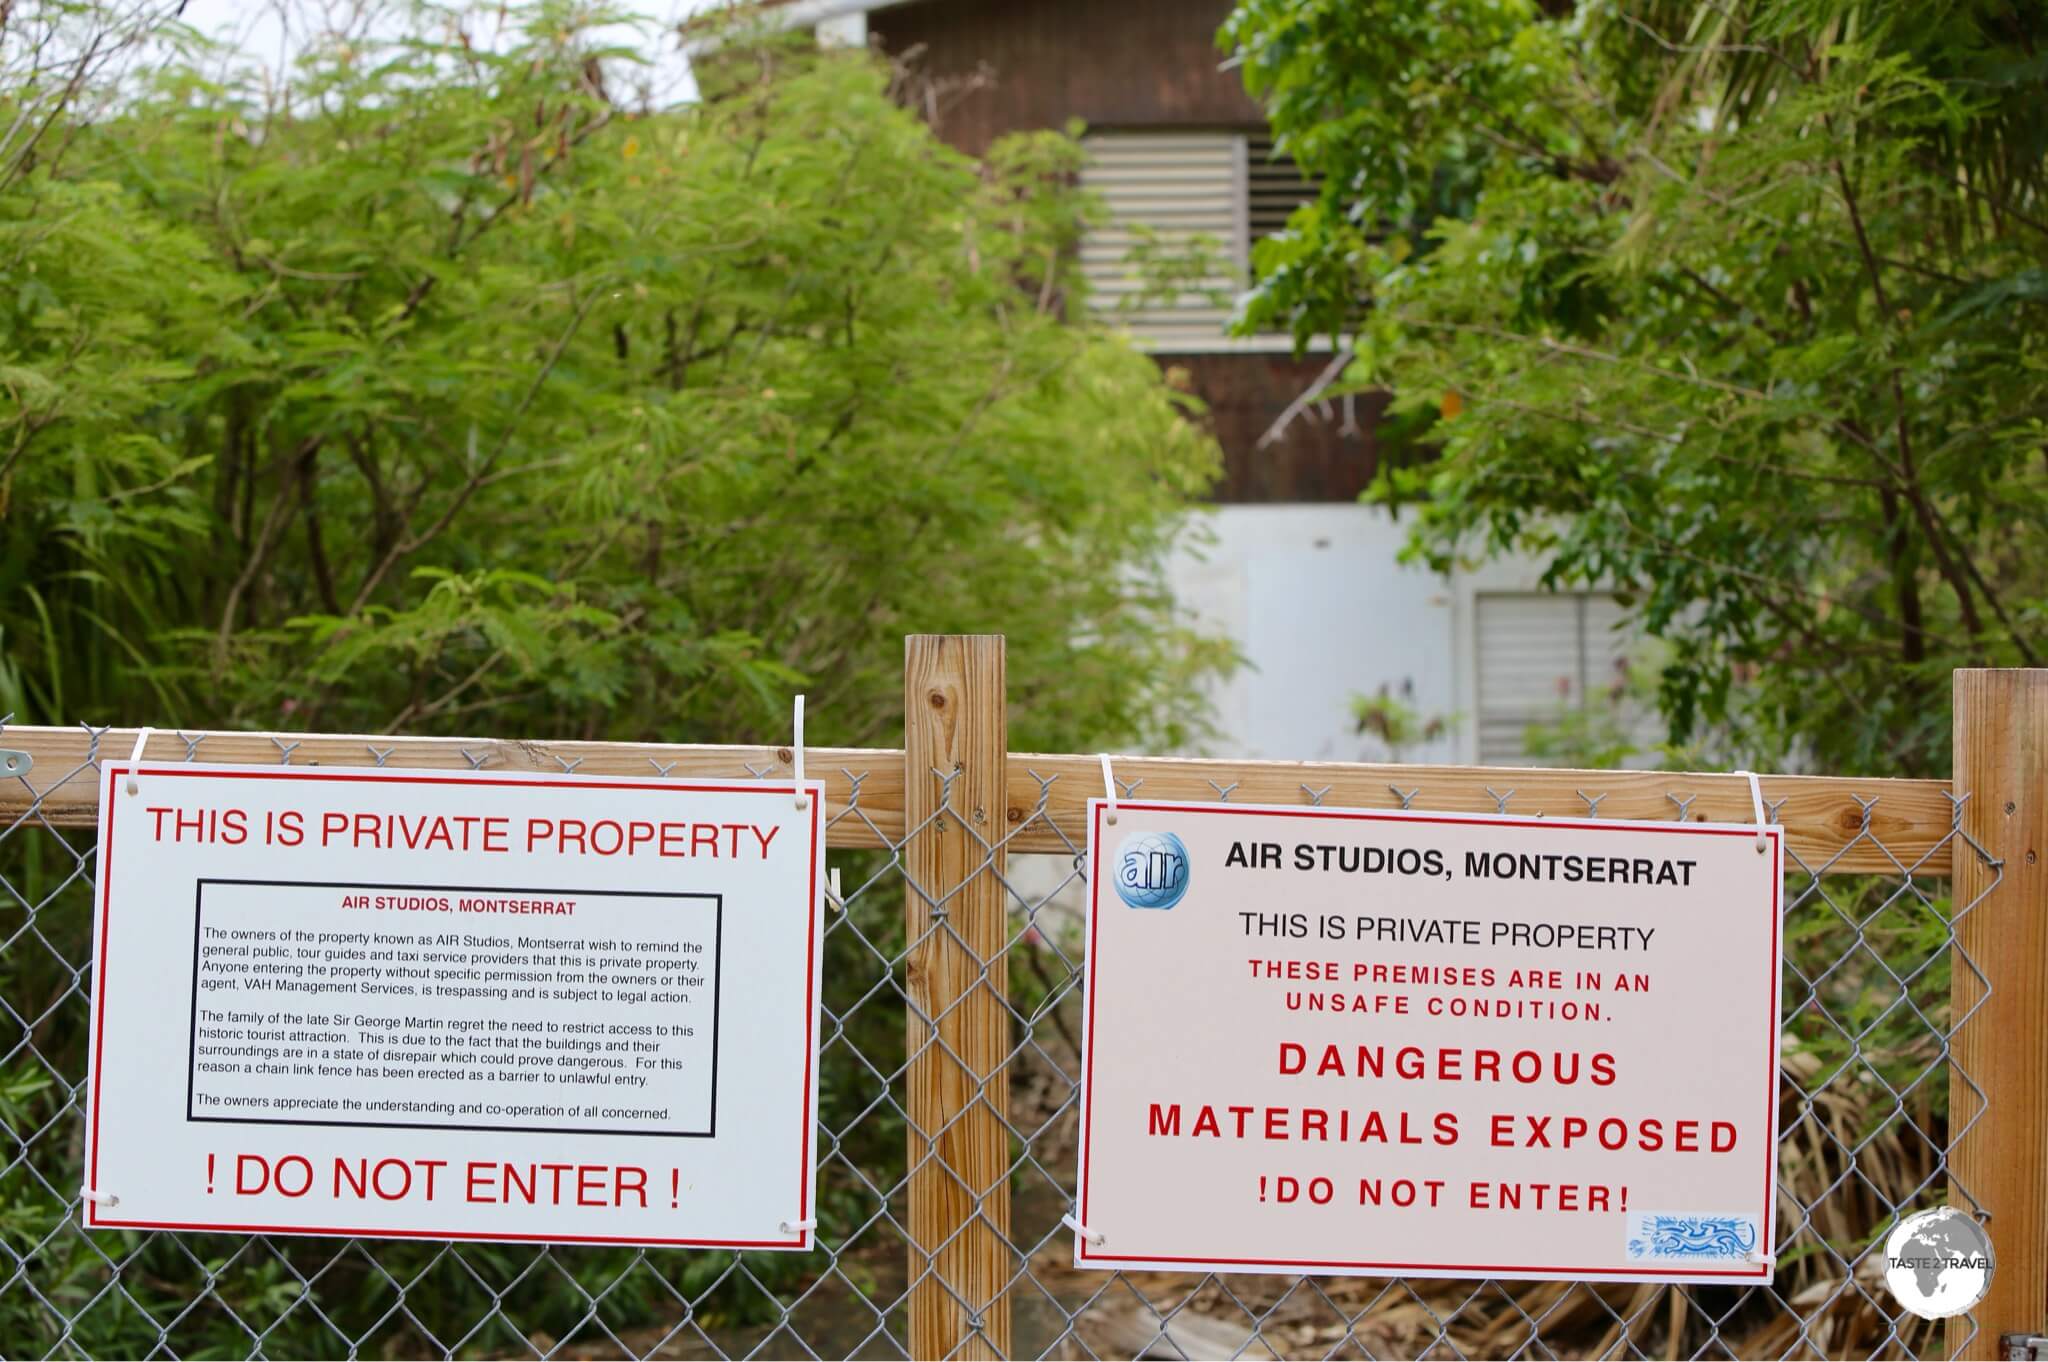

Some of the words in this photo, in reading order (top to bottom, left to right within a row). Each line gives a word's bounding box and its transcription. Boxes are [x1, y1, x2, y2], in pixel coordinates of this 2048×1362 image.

[145, 806, 247, 845] THIS
[265, 810, 304, 847] IS
[321, 811, 509, 852] PRIVATE
[526, 817, 780, 860] PROPERTY
[1224, 840, 1282, 869] AIR
[1293, 843, 1452, 882] STUDIOS,
[1464, 850, 1697, 886] MONTSERRAT
[341, 895, 369, 909] AIR
[374, 895, 453, 914] STUDIOS,
[458, 898, 576, 915] MONTSERRAT
[202, 926, 227, 939] The
[230, 929, 276, 941] owners
[279, 929, 292, 941] of
[295, 929, 314, 942] the
[318, 932, 370, 946] property
[373, 931, 413, 944] known
[417, 935, 432, 945] as
[435, 933, 459, 947] AIR
[463, 934, 513, 949] Studios,
[517, 935, 584, 950] Montserrat
[588, 938, 616, 951] wish
[620, 939, 632, 952] to
[636, 940, 679, 952] remind
[683, 940, 702, 953] the
[1238, 911, 1307, 938] THIS
[1319, 914, 1345, 940] IS
[1356, 915, 1480, 945] PRIVATE
[1491, 921, 1655, 951] PROPERTY
[201, 944, 249, 958] general
[252, 945, 292, 959] public,
[296, 946, 321, 958] tour
[324, 947, 366, 962] guides
[369, 948, 393, 960] and
[397, 949, 419, 962] taxi
[422, 951, 467, 963] service
[470, 952, 528, 966] providers
[532, 953, 556, 966] that
[559, 954, 582, 966] this
[585, 954, 595, 967] is
[599, 955, 641, 970] private
[645, 958, 699, 972] property.
[201, 959, 249, 975] Anyone
[252, 962, 303, 977] entering
[306, 963, 326, 975] the
[329, 965, 381, 979] property
[385, 966, 430, 979] without
[433, 967, 480, 981] specific
[484, 969, 552, 984] permission
[556, 970, 584, 983] from
[587, 971, 608, 984] the
[611, 974, 656, 985] owners
[660, 975, 673, 986] or
[677, 974, 704, 987] their
[1247, 959, 1339, 981] THESE
[1353, 962, 1495, 987] PREMISES
[1507, 968, 1562, 989] ARE
[1575, 971, 1601, 991] IN
[1613, 972, 1649, 992] AN
[200, 978, 239, 991] agent,
[243, 977, 271, 990] VAH
[275, 978, 356, 995] Management
[360, 981, 417, 996] Services,
[421, 983, 432, 996] is
[436, 984, 507, 1000] trespassing
[511, 986, 535, 998] and
[538, 986, 549, 999] is
[552, 987, 597, 1003] subject
[601, 989, 613, 1001] to
[617, 989, 646, 1004] legal
[650, 990, 691, 1003] action.
[1285, 991, 1408, 1014] UNSAFE
[1427, 996, 1611, 1022] CONDITION.
[199, 1009, 223, 1022] The
[227, 1010, 264, 1026] family
[267, 1011, 280, 1024] of
[283, 1012, 303, 1024] the
[306, 1012, 329, 1025] late
[332, 1013, 351, 1026] Sir
[354, 1014, 400, 1031] George
[404, 1015, 443, 1029] Martin
[447, 1018, 484, 1033] regret
[488, 1018, 507, 1031] the
[511, 1019, 542, 1032] need
[546, 1020, 558, 1032] to
[562, 1021, 604, 1034] restrict
[608, 1024, 652, 1035] access
[655, 1024, 668, 1036] to
[671, 1023, 693, 1036] this
[198, 1026, 243, 1040] historic
[247, 1028, 285, 1041] tourist
[288, 1029, 349, 1043] attraction.
[357, 1031, 384, 1044] This
[388, 1032, 398, 1044] is
[401, 1032, 426, 1045] due
[429, 1034, 441, 1046] to
[445, 1034, 464, 1046] the
[468, 1034, 491, 1048] fact
[494, 1035, 519, 1048] that
[522, 1036, 542, 1049] the
[545, 1036, 601, 1053] buildings
[604, 1039, 628, 1051] and
[632, 1039, 660, 1052] their
[198, 1044, 279, 1060] surroundings
[282, 1048, 303, 1058] are
[306, 1046, 317, 1058] in
[321, 1049, 329, 1059] a
[332, 1048, 363, 1060] state
[367, 1047, 379, 1061] of
[382, 1048, 437, 1064] disrepair
[440, 1050, 476, 1063] which
[480, 1052, 514, 1064] could
[517, 1055, 553, 1068] prove
[556, 1054, 627, 1070] dangerous.
[635, 1056, 657, 1069] For
[660, 1057, 683, 1070] this
[1278, 1041, 1616, 1086] DANGEROUS
[197, 1062, 240, 1072] reason
[243, 1063, 252, 1073] a
[255, 1061, 289, 1074] chain
[292, 1062, 314, 1075] link
[317, 1063, 352, 1076] fence
[356, 1064, 378, 1077] has
[382, 1065, 413, 1078] been
[417, 1068, 464, 1080] erected
[468, 1070, 483, 1080] as
[487, 1071, 495, 1081] a
[498, 1069, 540, 1082] barrier
[543, 1071, 555, 1083] to
[559, 1071, 610, 1085] unlawful
[614, 1073, 648, 1088] entry.
[195, 1092, 220, 1105] The
[223, 1096, 269, 1107] owners
[272, 1096, 338, 1111] appreciate
[342, 1097, 362, 1110] the
[365, 1098, 454, 1116] understanding
[458, 1101, 482, 1114] and
[485, 1103, 564, 1118] co-operation
[567, 1104, 580, 1117] of
[583, 1104, 597, 1118] all
[601, 1107, 670, 1120] concerned.
[1148, 1103, 1459, 1146] MATERIALS
[1490, 1114, 1737, 1153] EXPOSED
[206, 1152, 215, 1194] !
[235, 1153, 313, 1198] DO
[333, 1156, 447, 1201] NOT
[465, 1160, 648, 1208] ENTER
[671, 1167, 679, 1209] !
[1258, 1175, 1333, 1205] !DO
[1359, 1178, 1445, 1208] NOT
[1469, 1181, 1627, 1213] ENTER!
